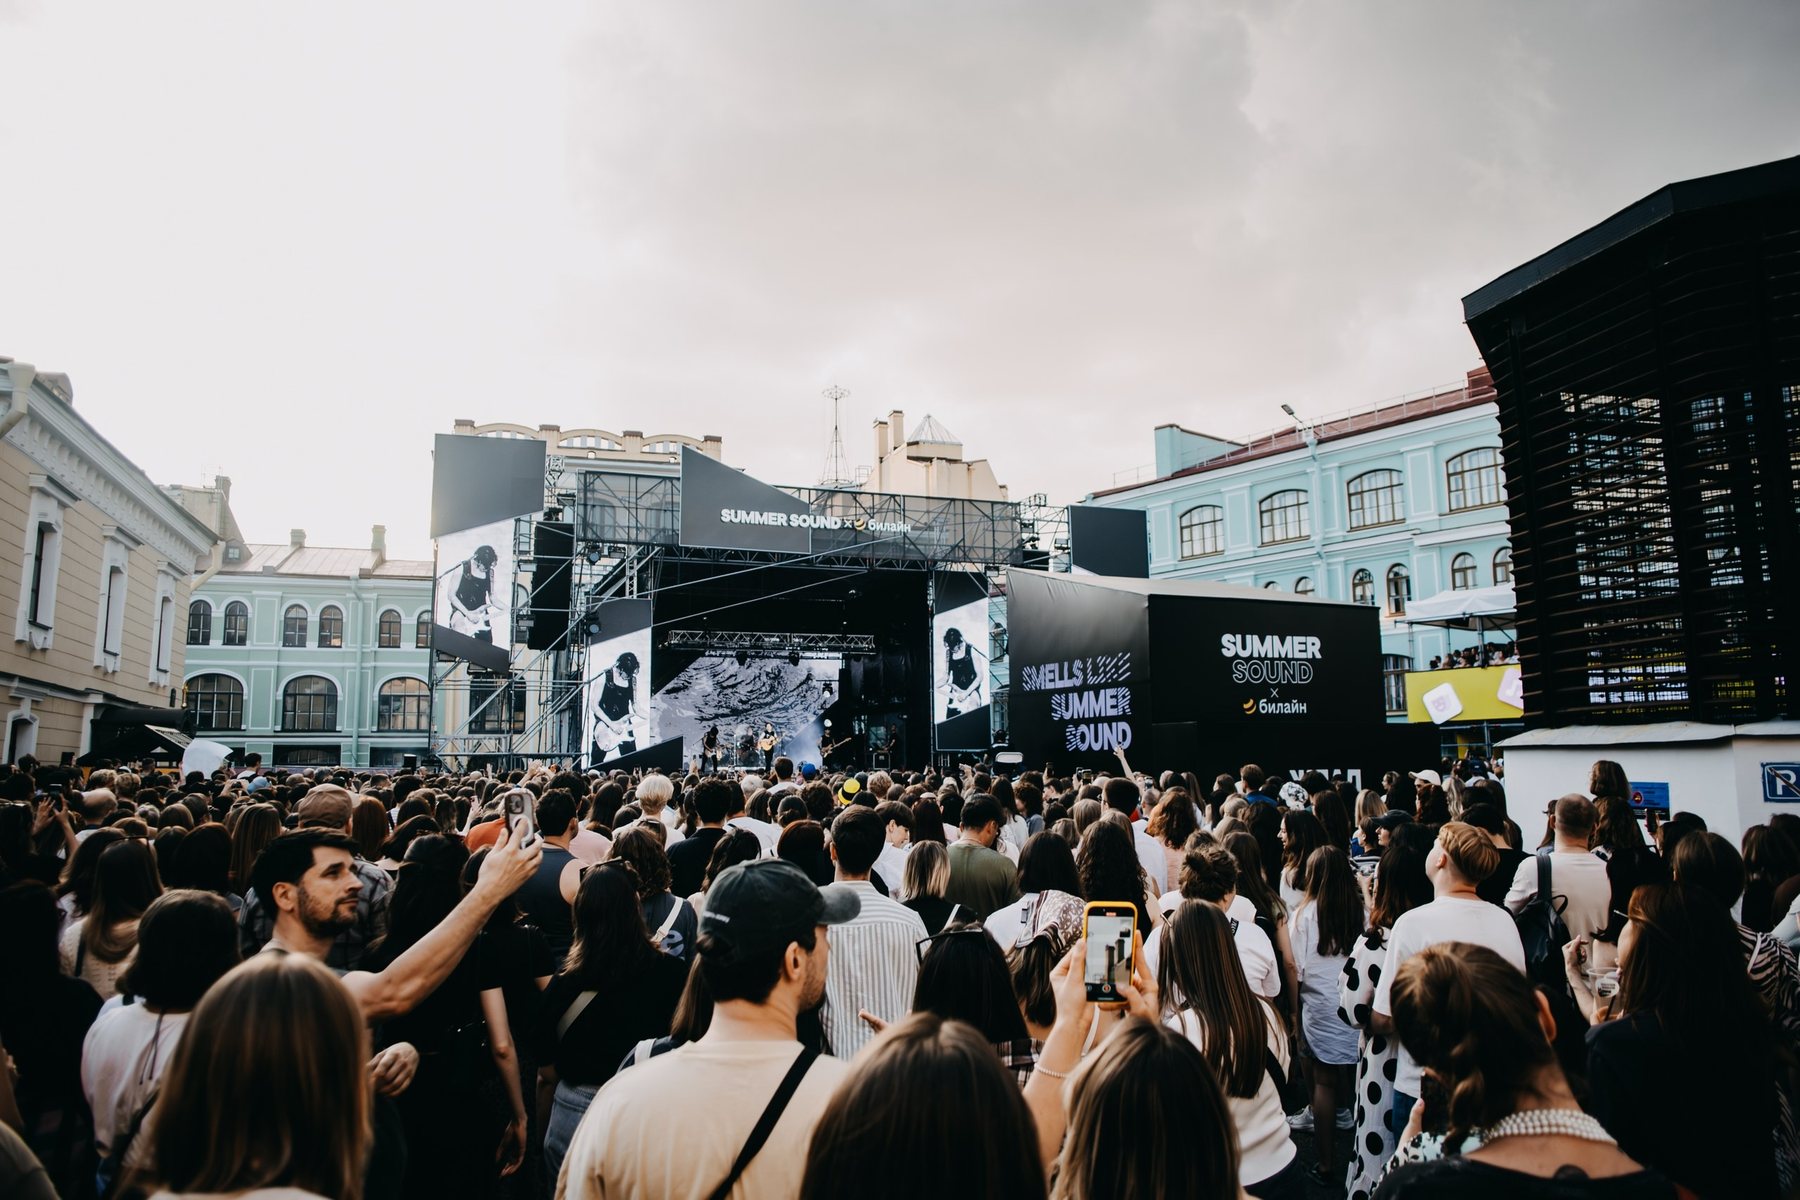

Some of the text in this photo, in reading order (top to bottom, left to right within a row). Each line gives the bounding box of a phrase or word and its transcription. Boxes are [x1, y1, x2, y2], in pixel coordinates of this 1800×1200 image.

[721, 508, 788, 526] SUMMER
[789, 513, 842, 530] SOUND
[867, 519, 912, 532] билайн
[1221, 633, 1322, 659] SUMMER
[1022, 659, 1084, 691] SMELLS
[1232, 659, 1313, 684] SOUND
[1051, 687, 1132, 721] SUMMER
[1259, 698, 1307, 714] билайн
[1065, 721, 1132, 752] SOUND
[1775, 769, 1797, 796] P
